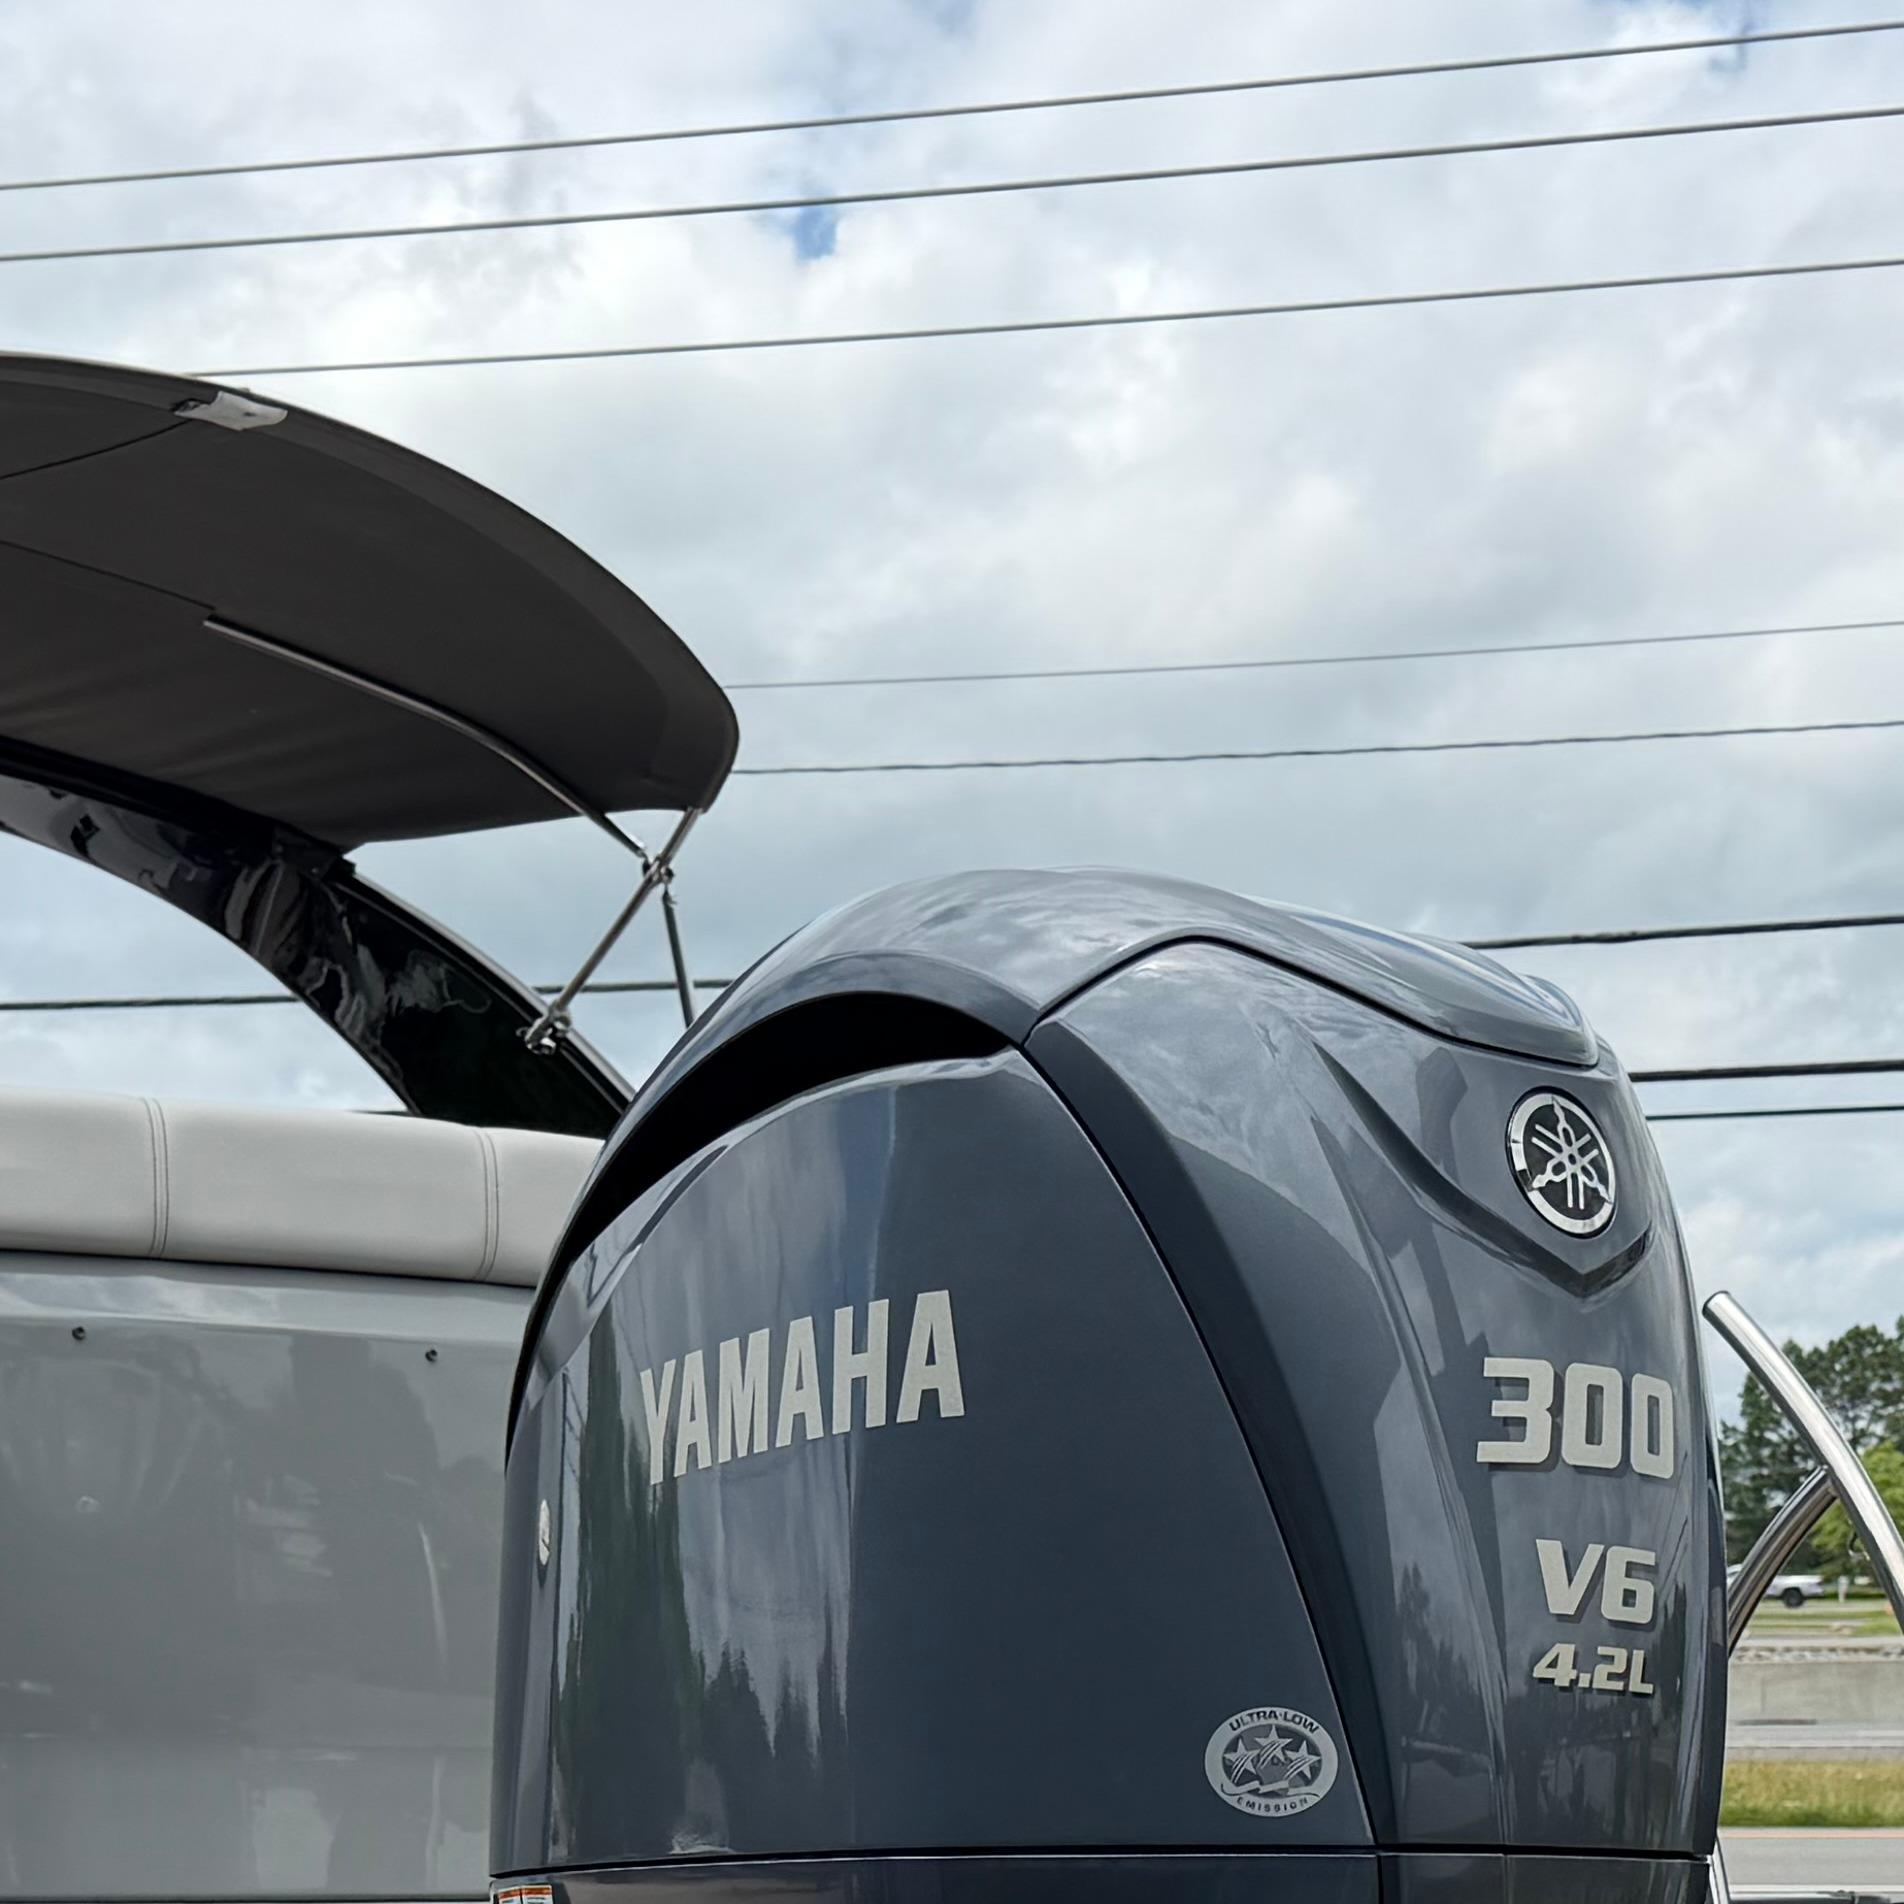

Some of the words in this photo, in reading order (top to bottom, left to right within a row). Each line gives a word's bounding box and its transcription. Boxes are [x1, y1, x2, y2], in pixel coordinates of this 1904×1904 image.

[639, 1289, 966, 1486] YAMAHA
[1476, 1356, 1675, 1479] 300
[1535, 1538, 1657, 1625] V6
[1532, 1642, 1655, 1695] 4.2L
[1236, 1796, 1308, 1813] EMISSION
